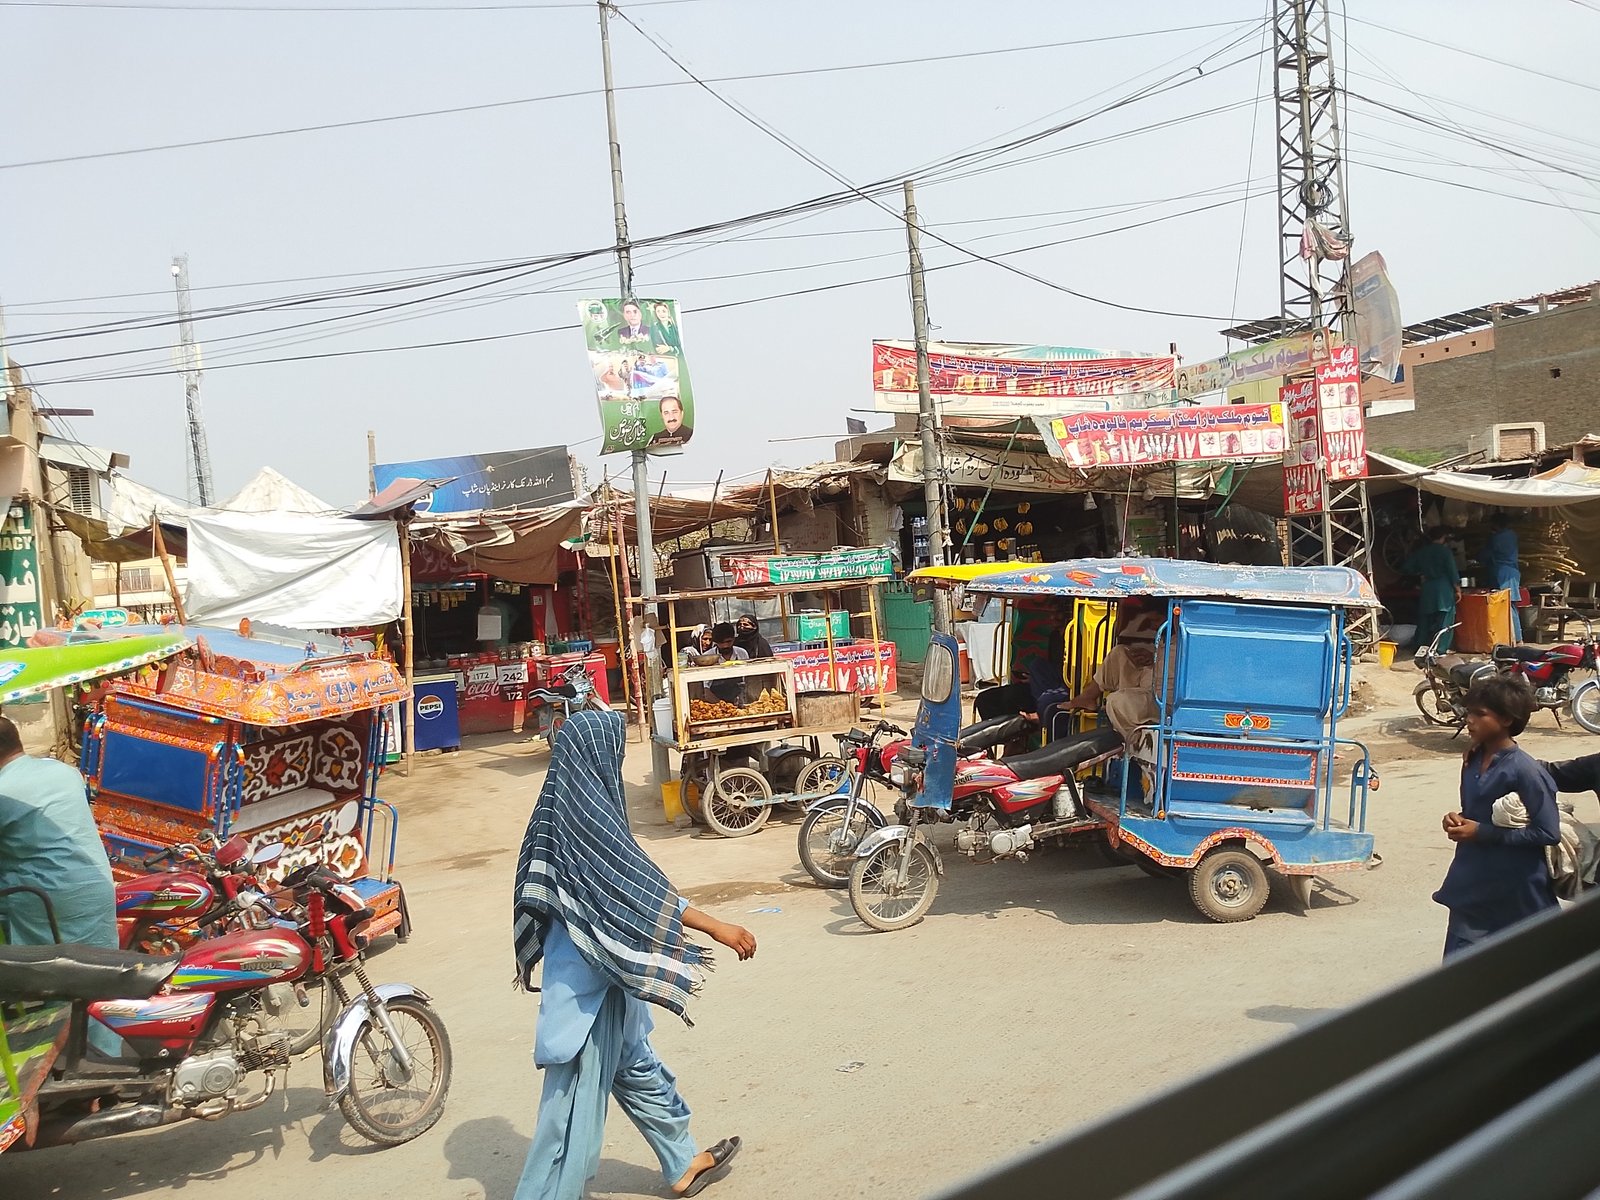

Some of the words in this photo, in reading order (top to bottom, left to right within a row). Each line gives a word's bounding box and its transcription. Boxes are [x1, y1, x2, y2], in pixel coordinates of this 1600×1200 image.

[1092, 415, 1127, 433] فالودہ
[1202, 411, 1217, 428] بار
[1217, 410, 1243, 425] ملک
[1243, 409, 1270, 428] قیوم
[1067, 415, 1092, 439] شاپ
[545, 472, 555, 489] بسم
[461, 483, 479, 498] شاپ
[502, 671, 523, 683] 242
[506, 691, 523, 701] 172
[420, 703, 442, 711] PEPSI
[240, 960, 284, 973] UNIQUE
